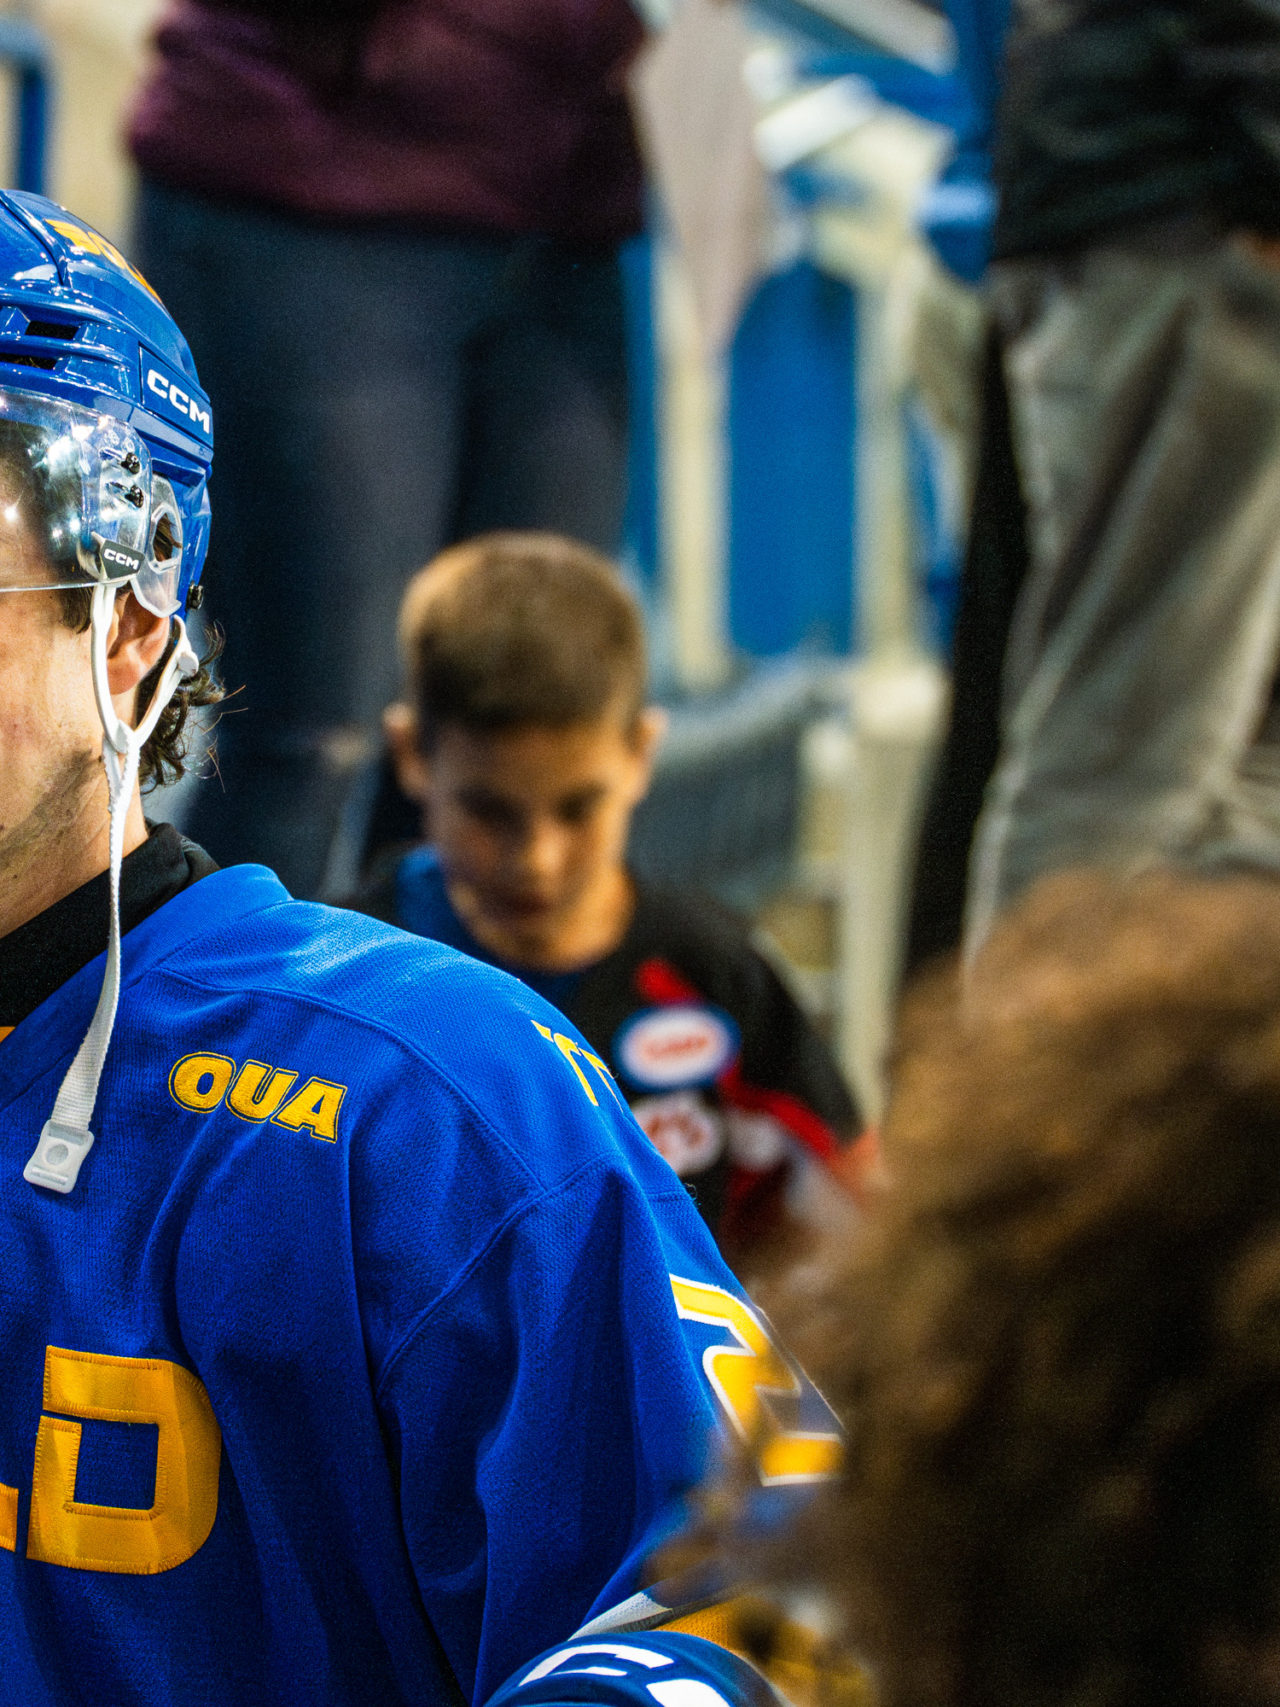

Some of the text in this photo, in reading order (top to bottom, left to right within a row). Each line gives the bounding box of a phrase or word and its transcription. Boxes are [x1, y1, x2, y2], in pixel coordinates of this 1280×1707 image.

[146, 368, 210, 434] CCM
[103, 548, 140, 570] CCM
[168, 1051, 348, 1144] OUA
